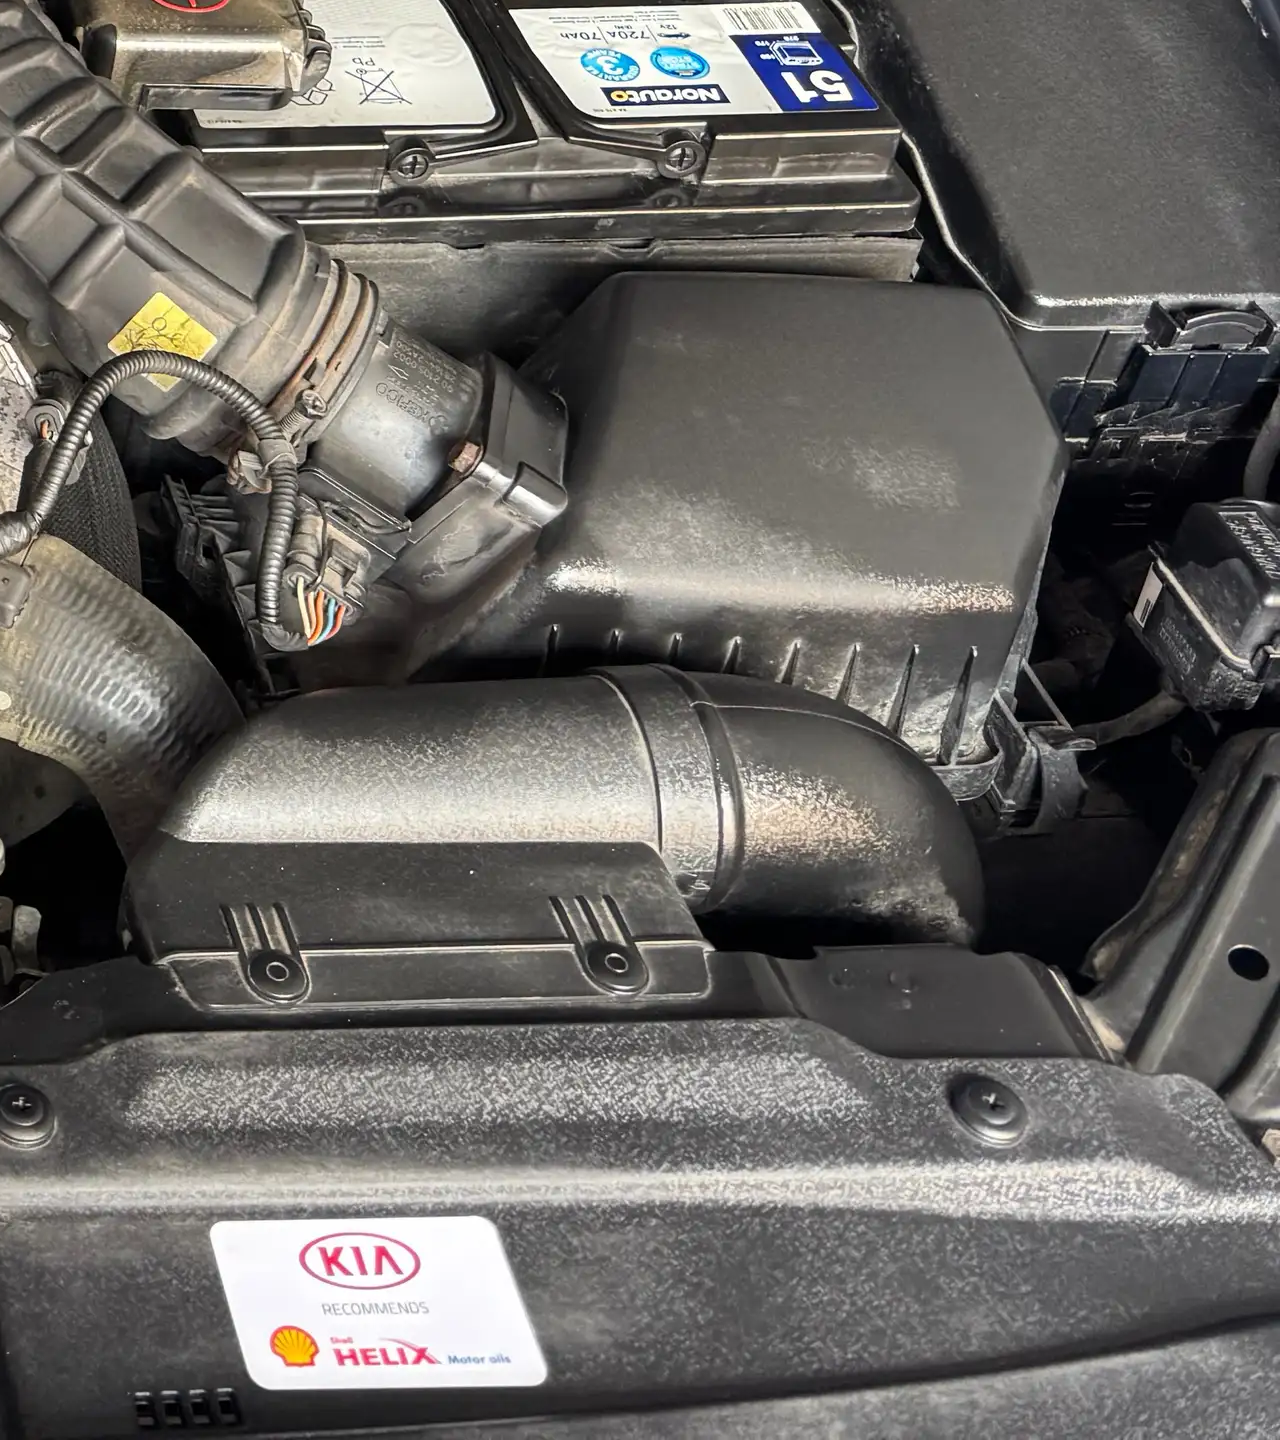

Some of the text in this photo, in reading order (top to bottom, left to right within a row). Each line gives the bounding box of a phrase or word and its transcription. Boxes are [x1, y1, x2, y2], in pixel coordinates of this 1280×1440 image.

[559, 31, 601, 40] 70Ah
[607, 30, 650, 40] 720A
[351, 57, 376, 67] Pb
[594, 55, 621, 76] 3
[781, 68, 854, 104] 51
[609, 87, 721, 105] Norauto
[317, 1245, 404, 1278] KIA
[321, 1300, 430, 1317] RECOMMENDS
[332, 1344, 511, 1367] HELIX Motor oils
